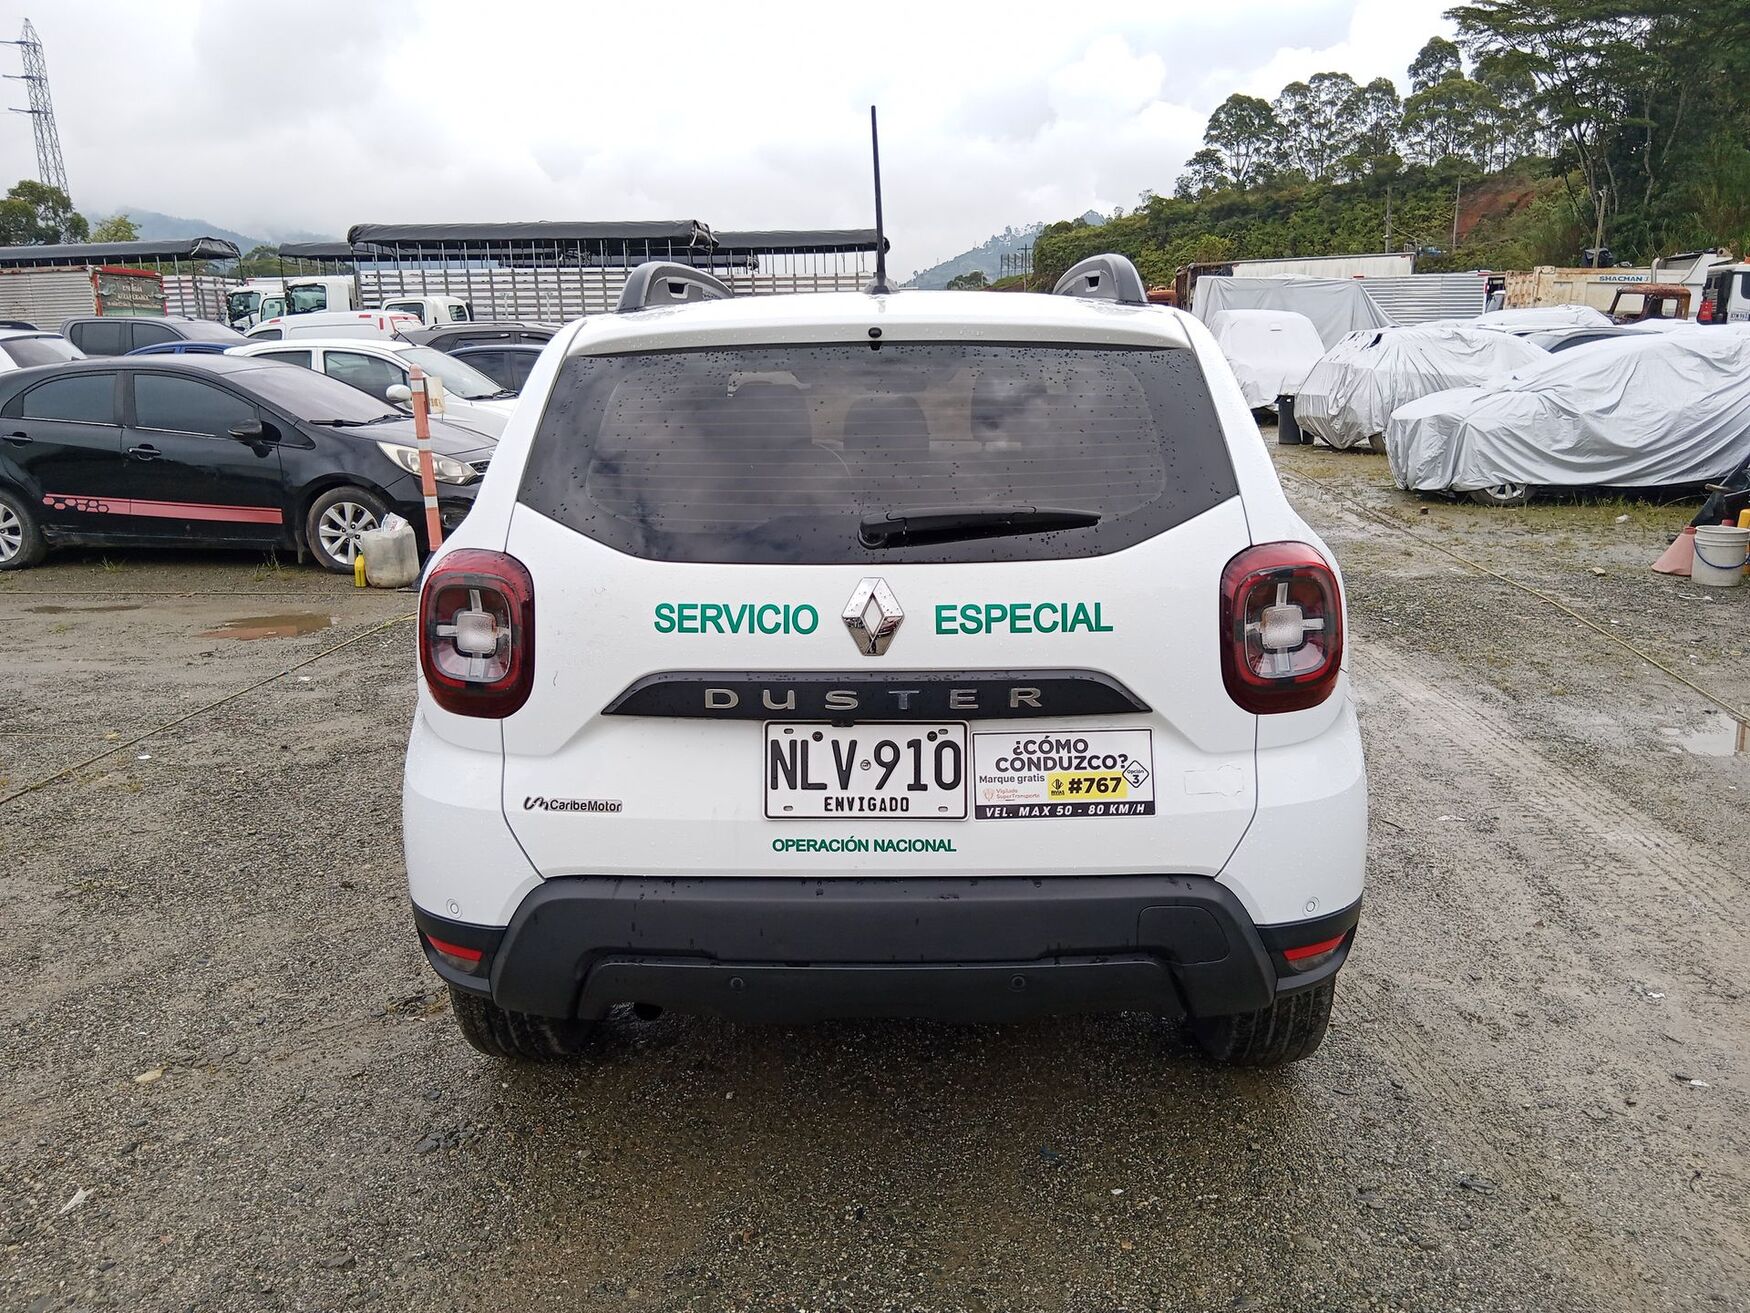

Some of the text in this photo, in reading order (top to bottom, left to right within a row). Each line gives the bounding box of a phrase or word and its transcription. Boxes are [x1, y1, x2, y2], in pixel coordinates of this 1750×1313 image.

[654, 602, 1114, 635] SERVICIO ESPECIAL
[704, 687, 1044, 711] DUSTER
[1012, 735, 1089, 756] ¿CÓMO
[770, 738, 962, 791] NLV 910
[995, 753, 1129, 773] CONDUZCO?
[979, 773, 1046, 785] Marque gratis
[1068, 776, 1122, 795] #767
[1132, 774, 1140, 785] 3
[550, 799, 622, 812] CaribeMotor
[823, 796, 910, 813] ENVIGADO
[985, 807, 1013, 818] VEL.
[1018, 805, 1052, 817] MAX
[1056, 805, 1073, 816] 50
[1088, 804, 1104, 815] 80
[1109, 803, 1146, 815] KM/H
[772, 835, 957, 853] OPERACIÓN NACIONAL
